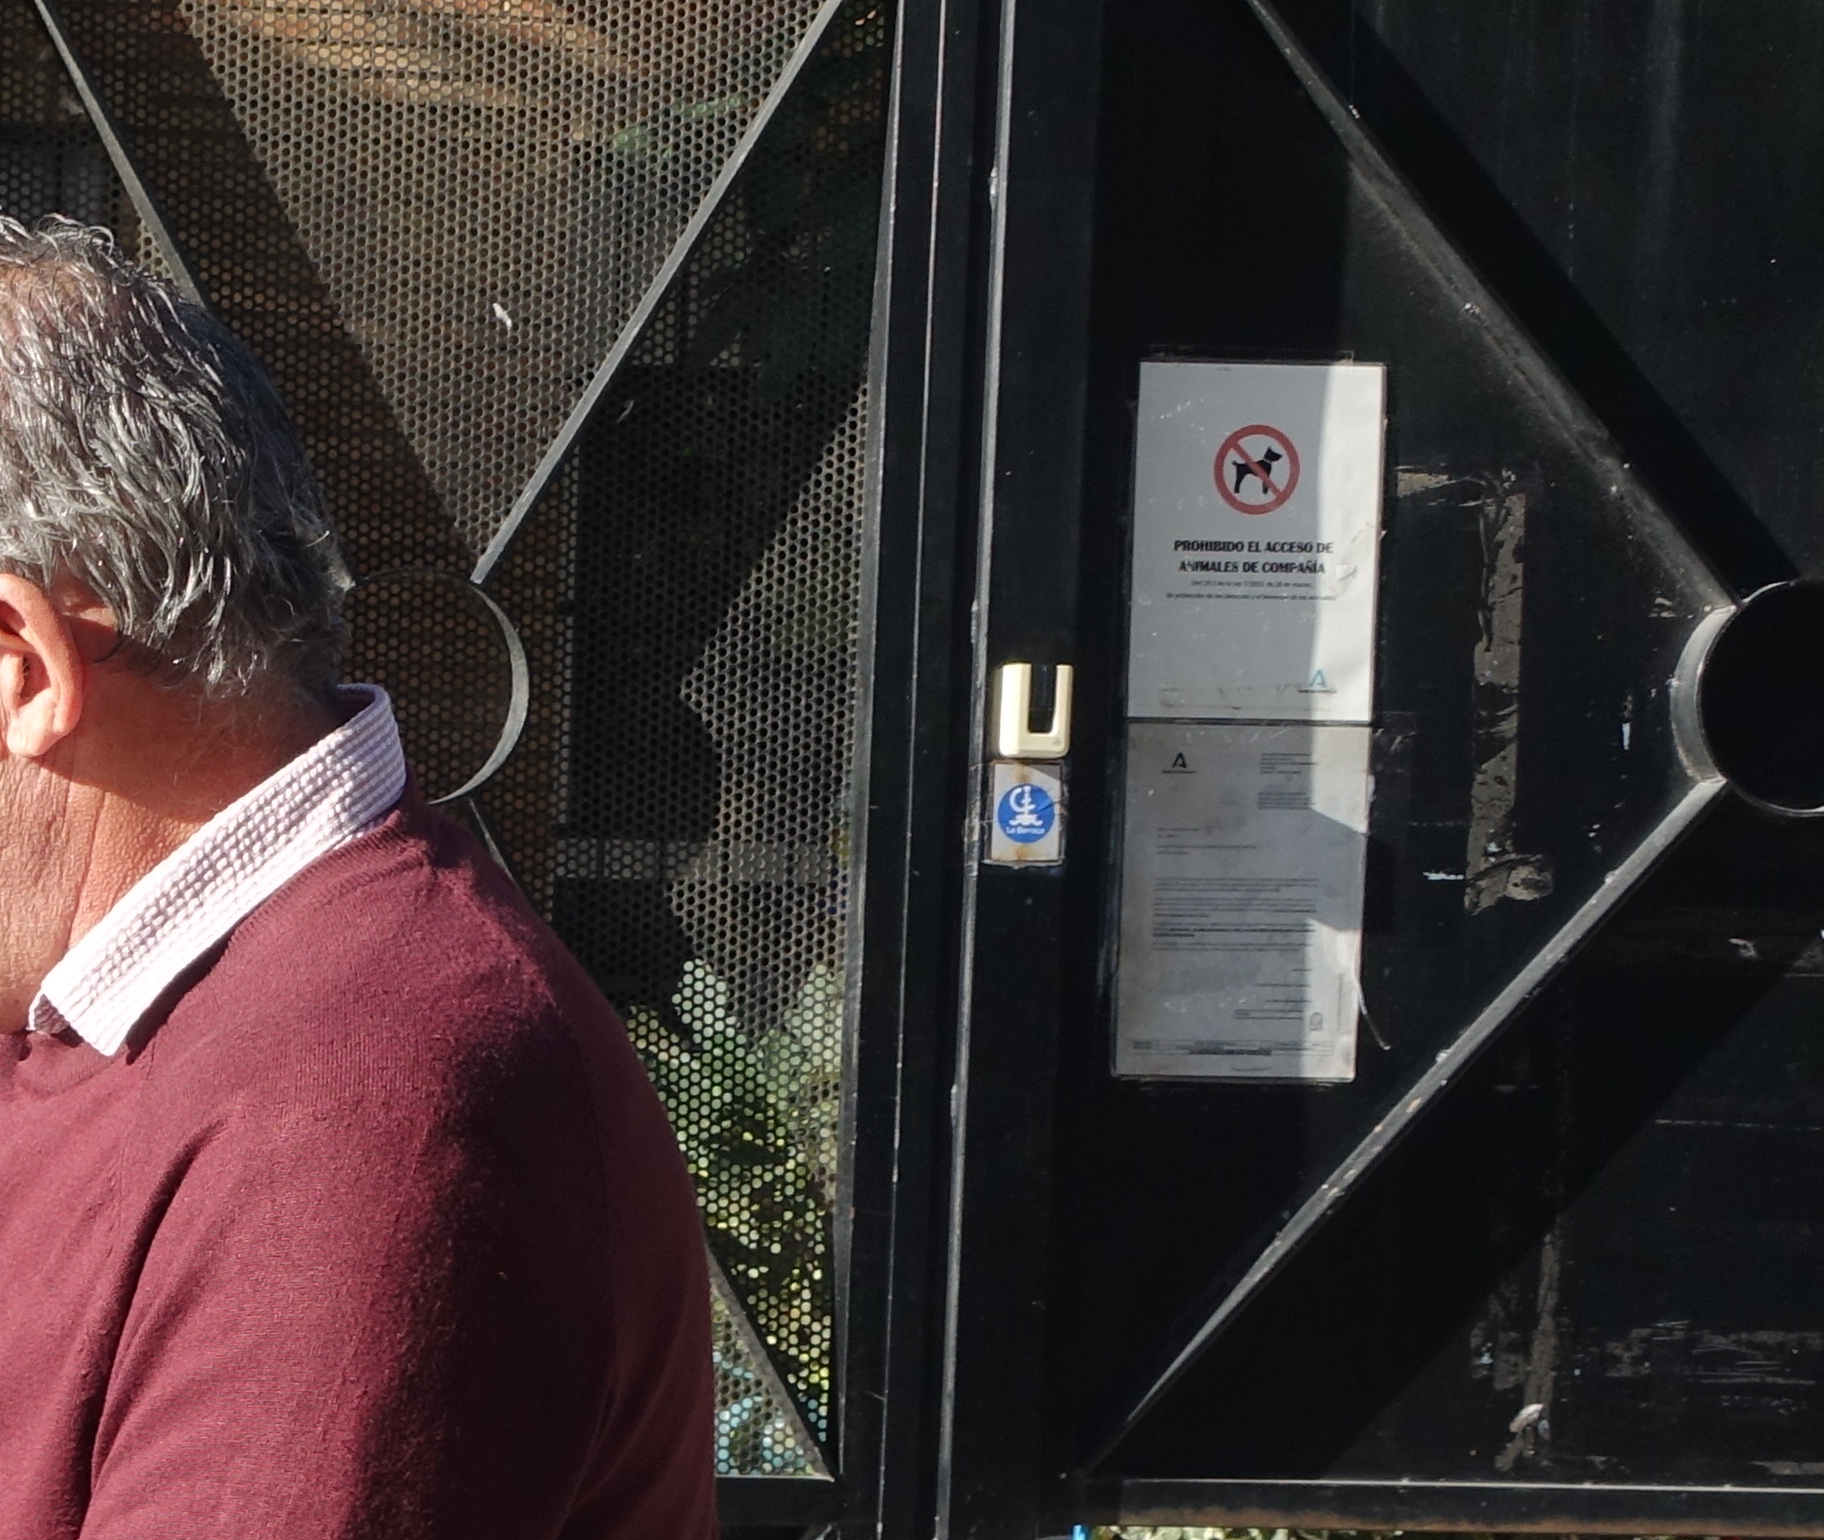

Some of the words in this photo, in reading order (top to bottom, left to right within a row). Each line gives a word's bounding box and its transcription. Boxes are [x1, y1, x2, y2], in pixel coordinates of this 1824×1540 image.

[1174, 540, 1244, 552] PROHIBIDO
[1248, 541, 1262, 553] EL
[1265, 541, 1313, 553] ACCESO
[1316, 542, 1334, 553] DE
[1242, 562, 1258, 573] DE
